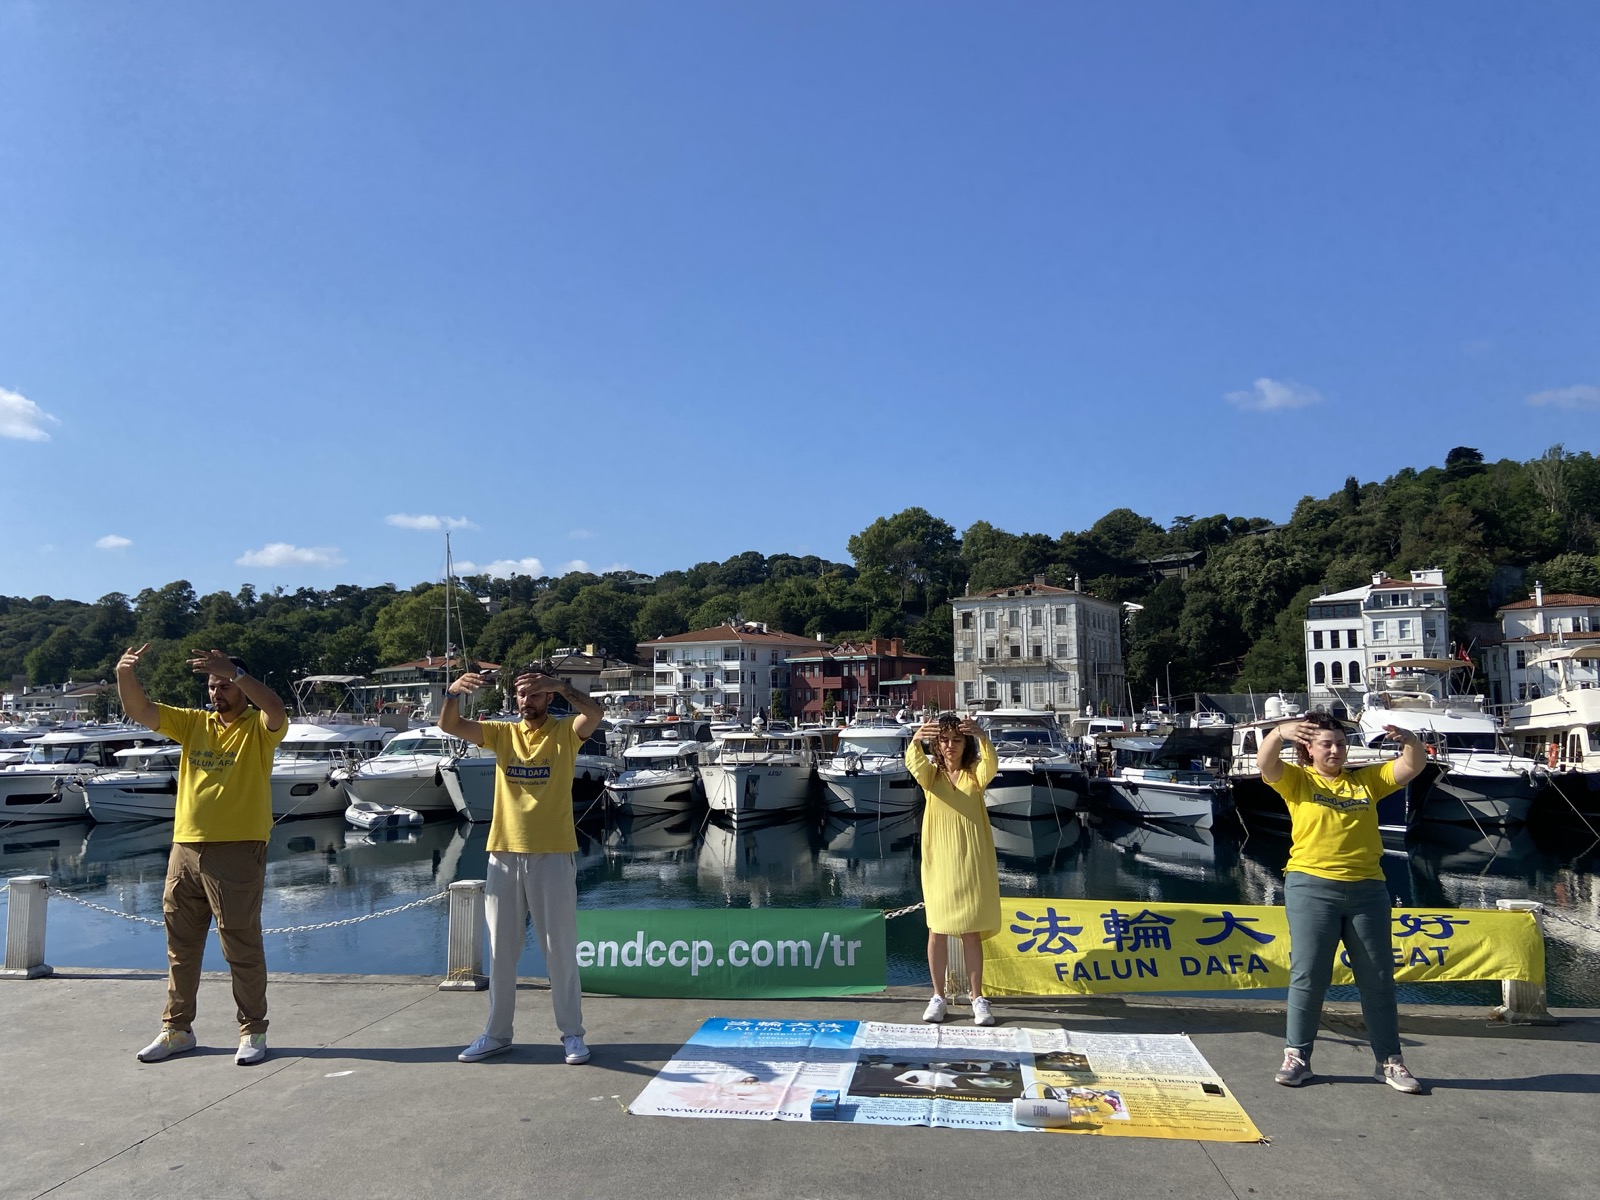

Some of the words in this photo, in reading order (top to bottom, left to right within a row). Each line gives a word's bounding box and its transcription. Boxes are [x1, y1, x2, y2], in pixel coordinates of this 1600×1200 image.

[528, 769, 550, 777] DAFA
[575, 930, 862, 977] endccp.com/tr
[1053, 957, 1159, 983] FALUN
[1179, 953, 1270, 978] DAFA
